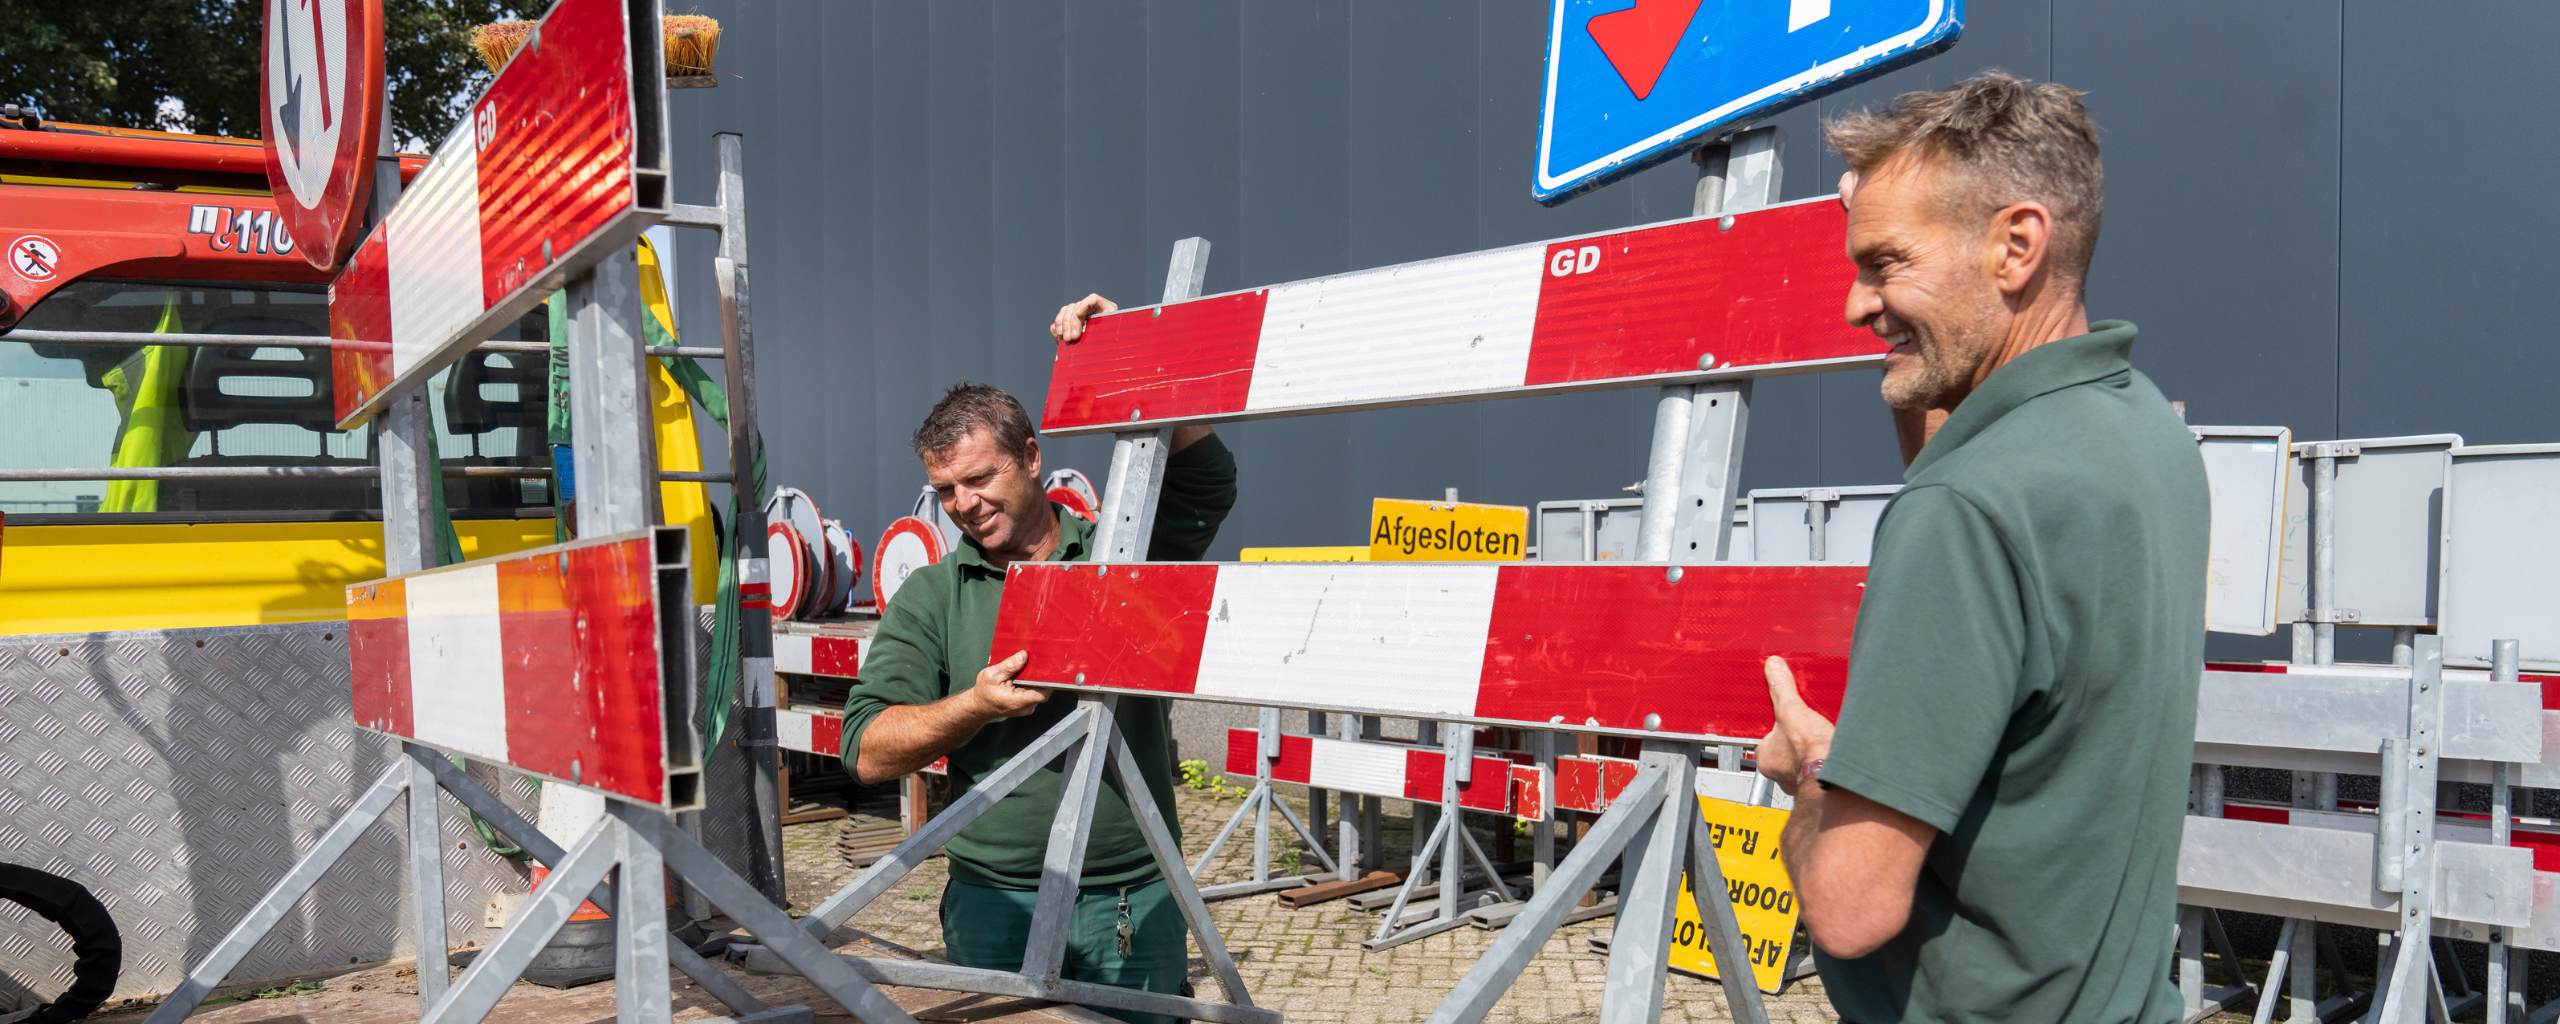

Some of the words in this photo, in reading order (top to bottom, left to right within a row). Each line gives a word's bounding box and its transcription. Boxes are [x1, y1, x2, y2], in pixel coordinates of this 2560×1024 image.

[477, 99, 497, 153] GD
[1550, 245, 1601, 277] GD
[552, 345, 570, 385] WLL
[1373, 515, 1520, 556] Afgesloten
